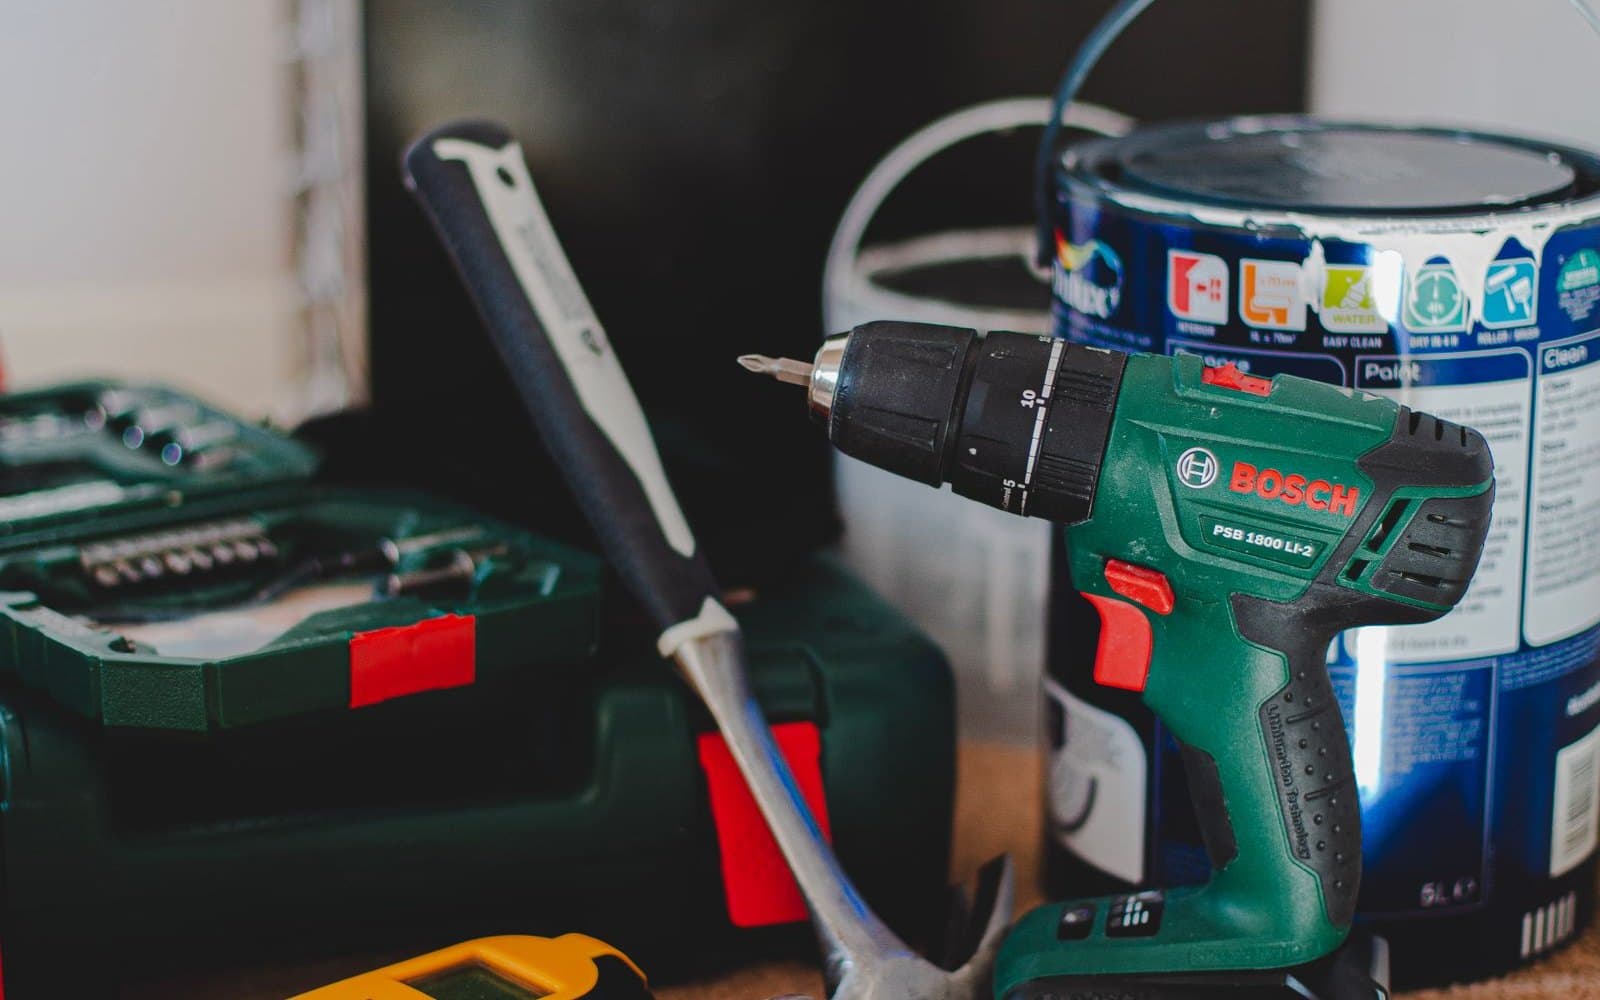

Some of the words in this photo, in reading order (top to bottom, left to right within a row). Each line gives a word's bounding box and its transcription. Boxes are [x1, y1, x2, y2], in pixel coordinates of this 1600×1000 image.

[1333, 314, 1375, 325] WATER
[1322, 335, 1348, 348] EASY
[1350, 336, 1383, 349] CLEAN
[1544, 345, 1588, 369] Clean
[1364, 362, 1420, 382] Paint
[1020, 389, 1037, 409] 10
[1003, 478, 1016, 488] 5
[1229, 461, 1359, 517] BOSCH
[1213, 524, 1243, 541] PSB
[1246, 531, 1282, 550] 1800
